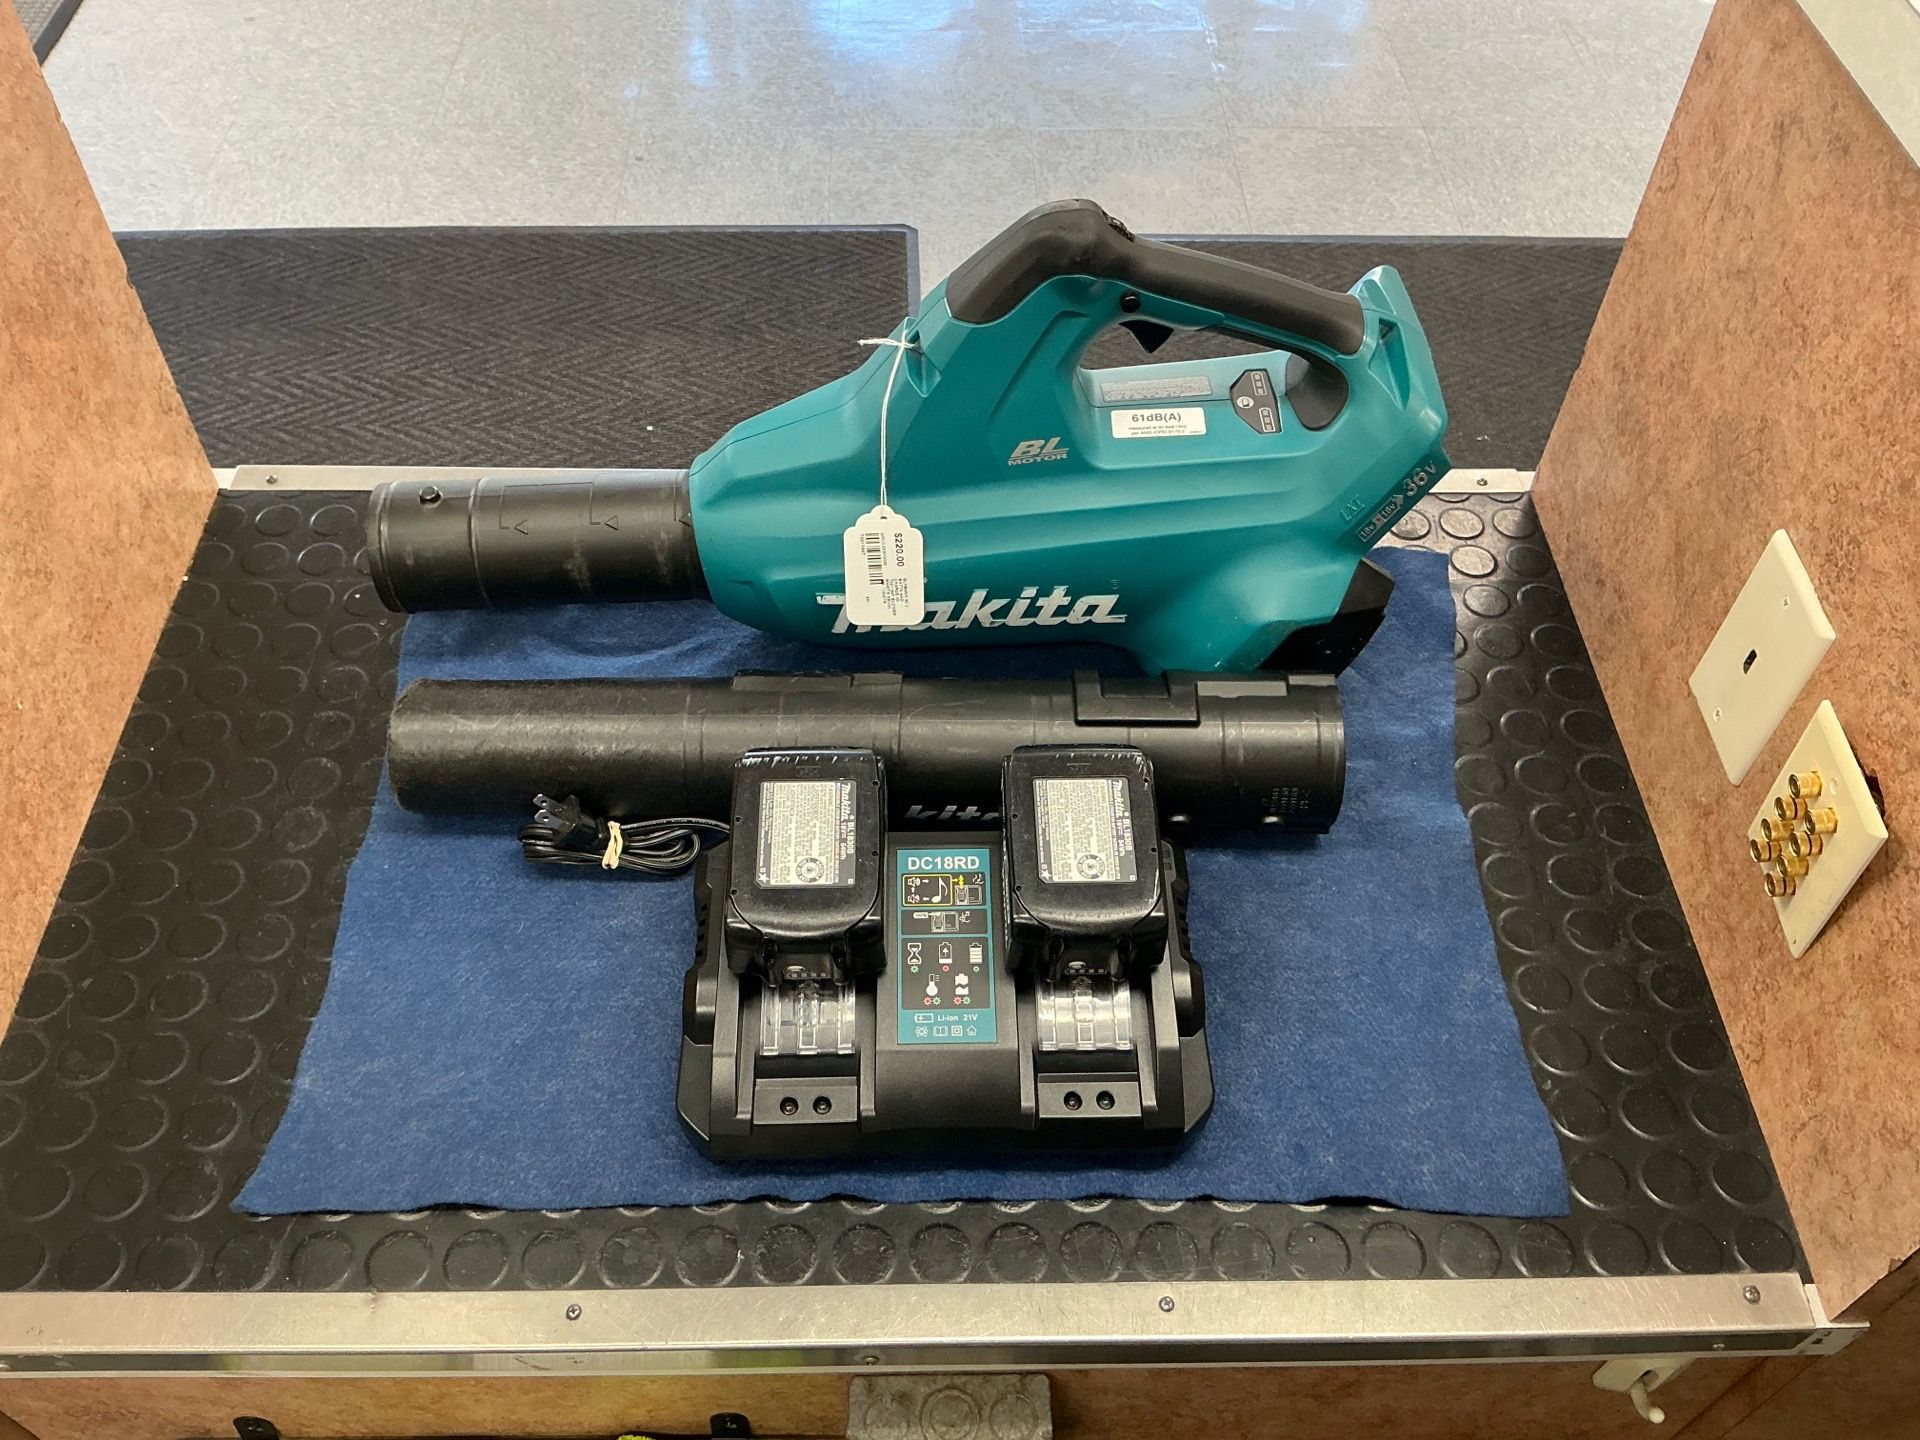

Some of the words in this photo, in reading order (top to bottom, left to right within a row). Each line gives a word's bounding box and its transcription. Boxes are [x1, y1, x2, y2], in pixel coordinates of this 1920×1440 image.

[1131, 412, 1181, 423] 61dB(A)
[1009, 436, 1069, 458] BL
[1008, 453, 1068, 466] MOTOR
[894, 532, 905, 567] $220.00
[847, 822, 855, 854] BL1830B
[1123, 819, 1133, 851] BL1830B
[908, 856, 980, 870] DC18RD
[963, 1013, 978, 1021] 21V
